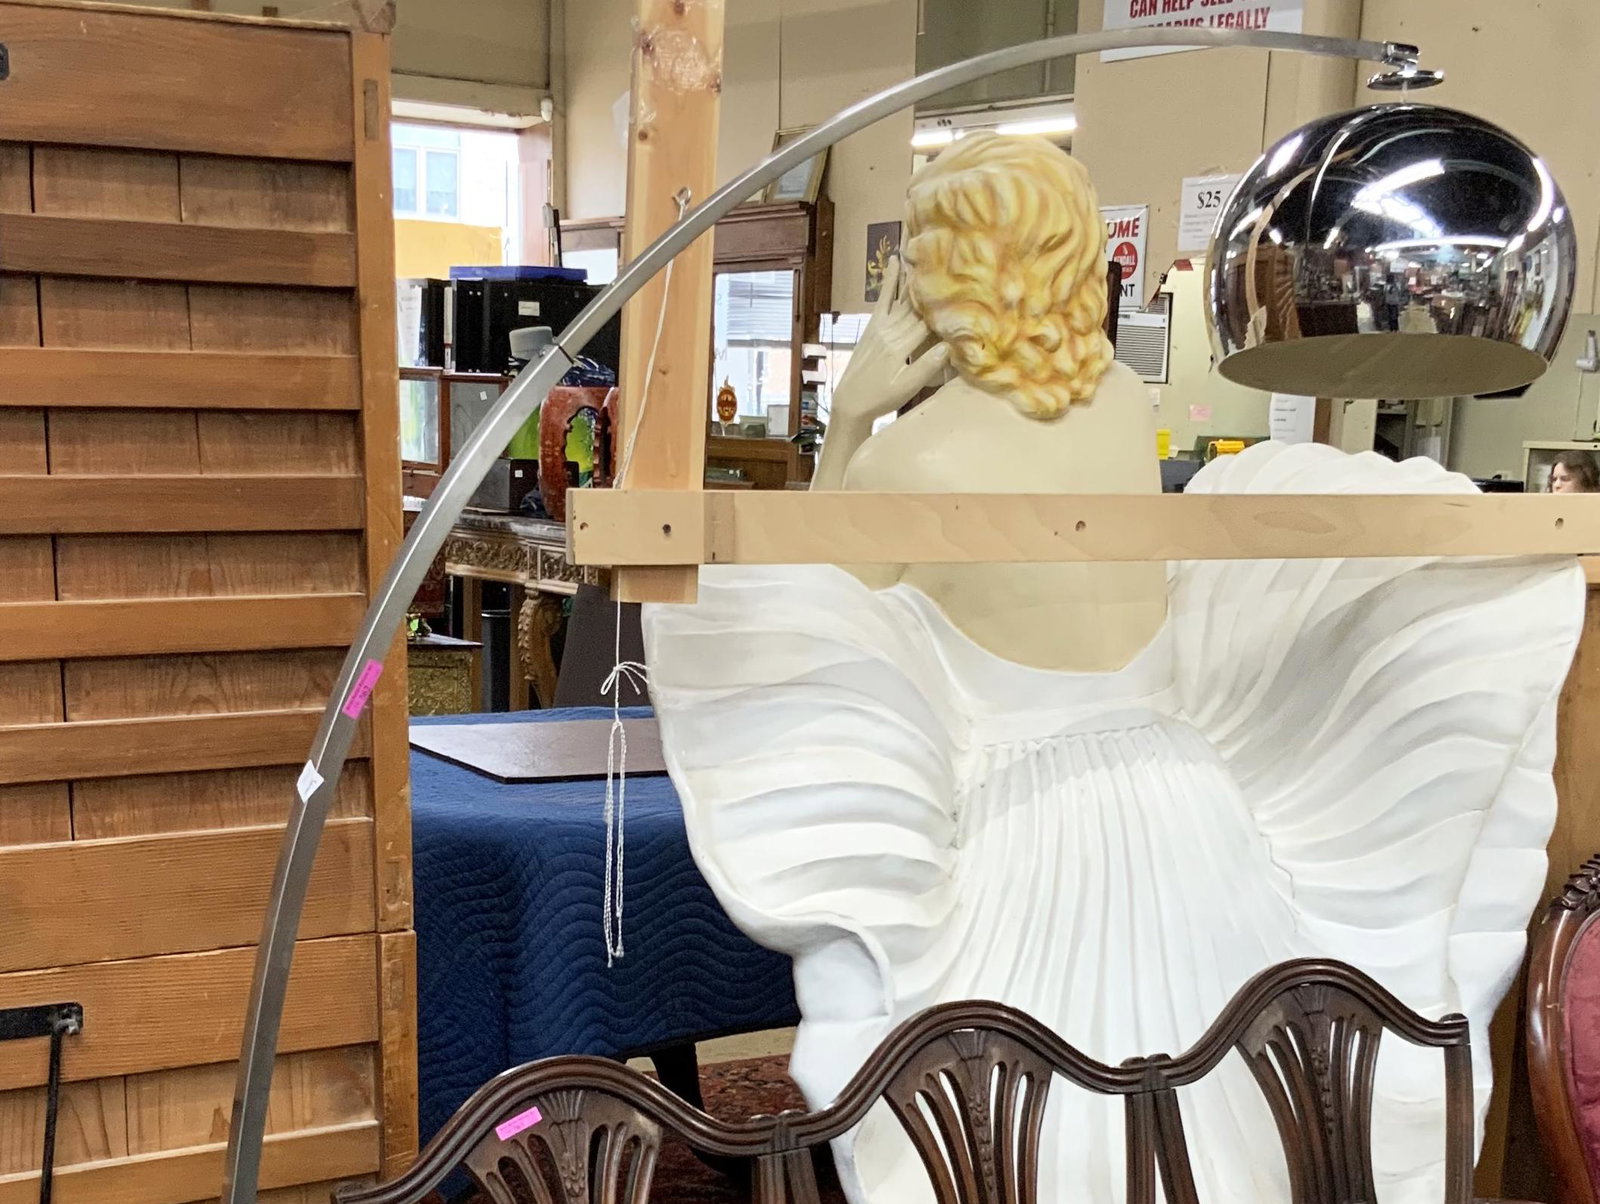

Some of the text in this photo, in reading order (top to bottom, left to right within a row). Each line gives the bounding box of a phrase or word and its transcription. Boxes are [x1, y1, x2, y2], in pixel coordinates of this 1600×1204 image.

[1130, 0, 1157, 18] CAN
[1210, 7, 1270, 29] LEGALLY
[1197, 190, 1221, 209] $25
